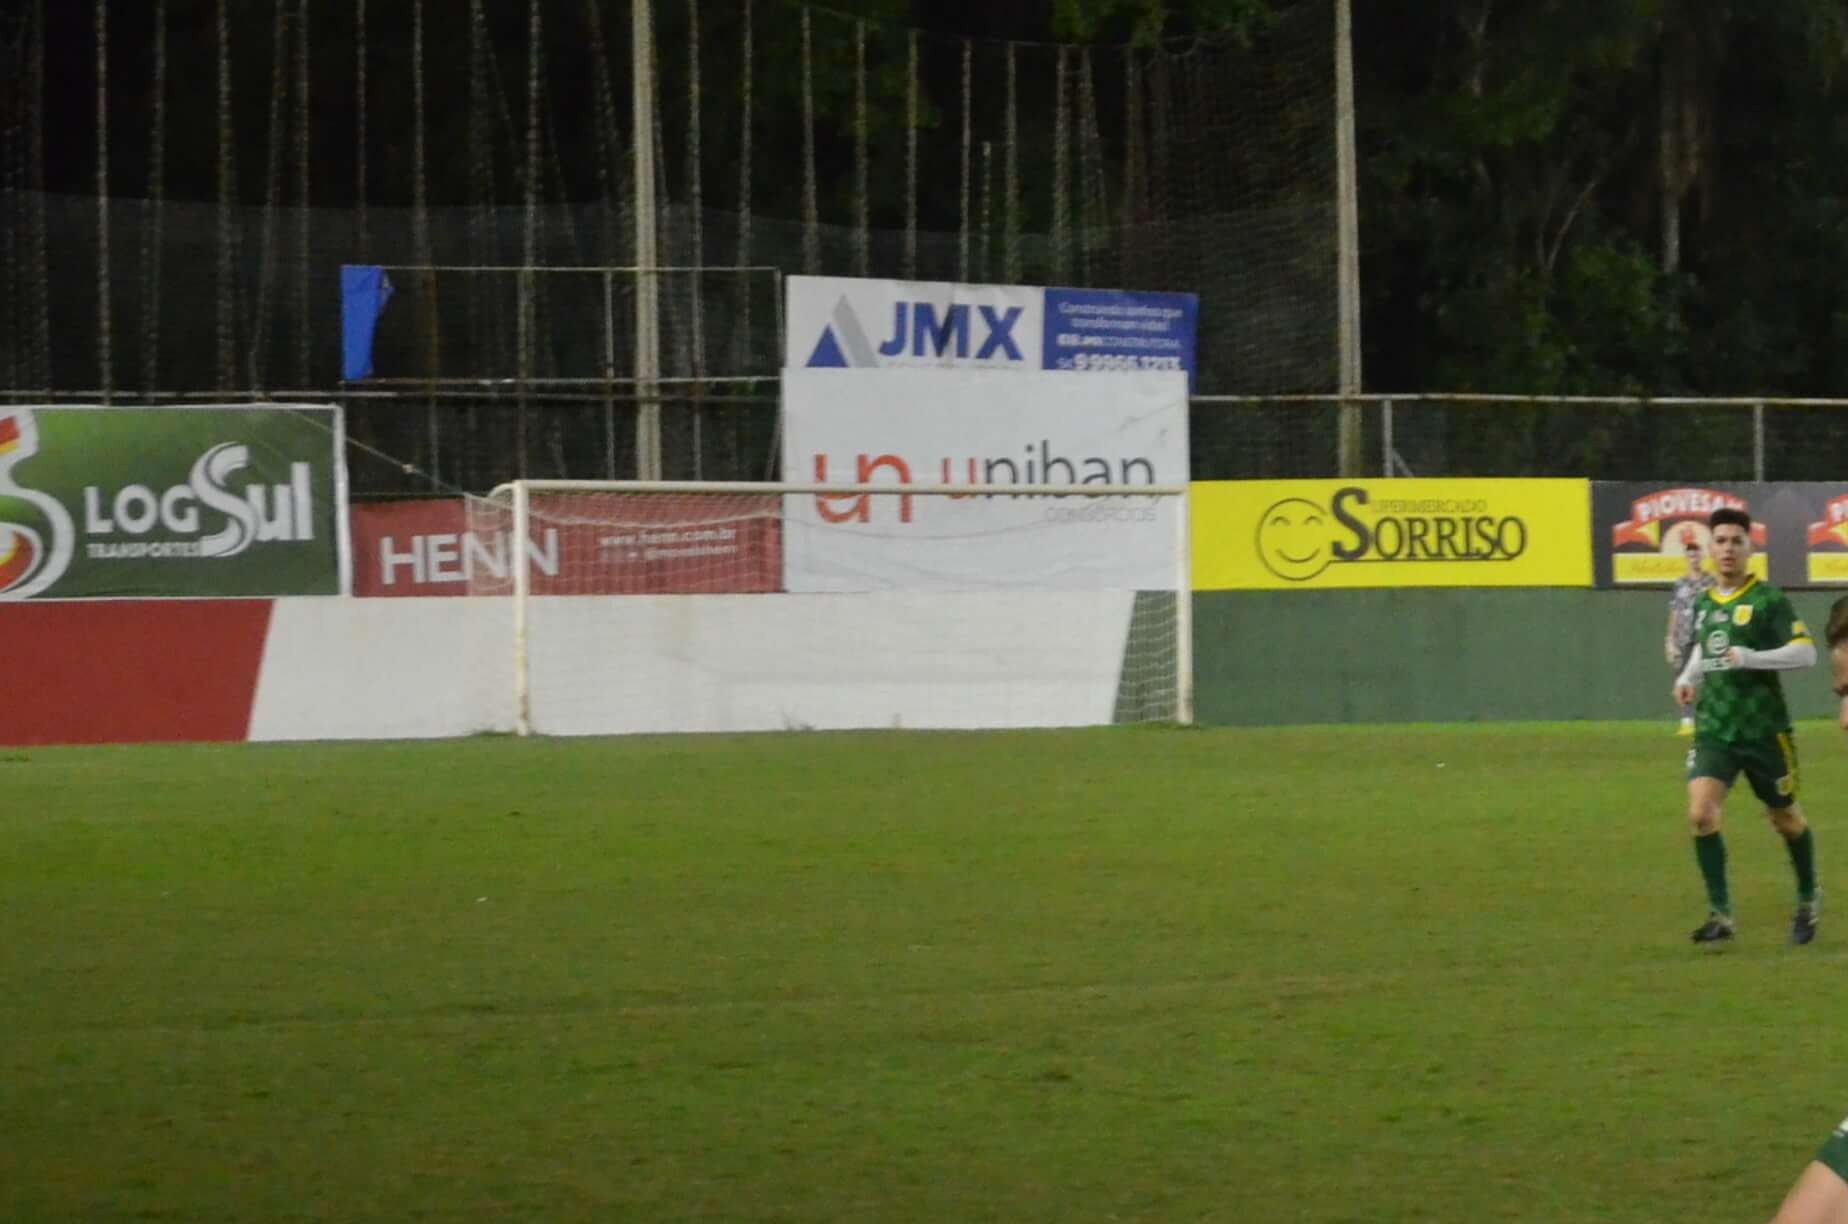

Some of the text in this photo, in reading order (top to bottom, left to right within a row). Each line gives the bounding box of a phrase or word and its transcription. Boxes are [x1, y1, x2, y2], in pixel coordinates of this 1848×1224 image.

[879, 301, 1023, 360] JMX
[941, 439, 1156, 499] uniban
[380, 528, 559, 585] HENN
